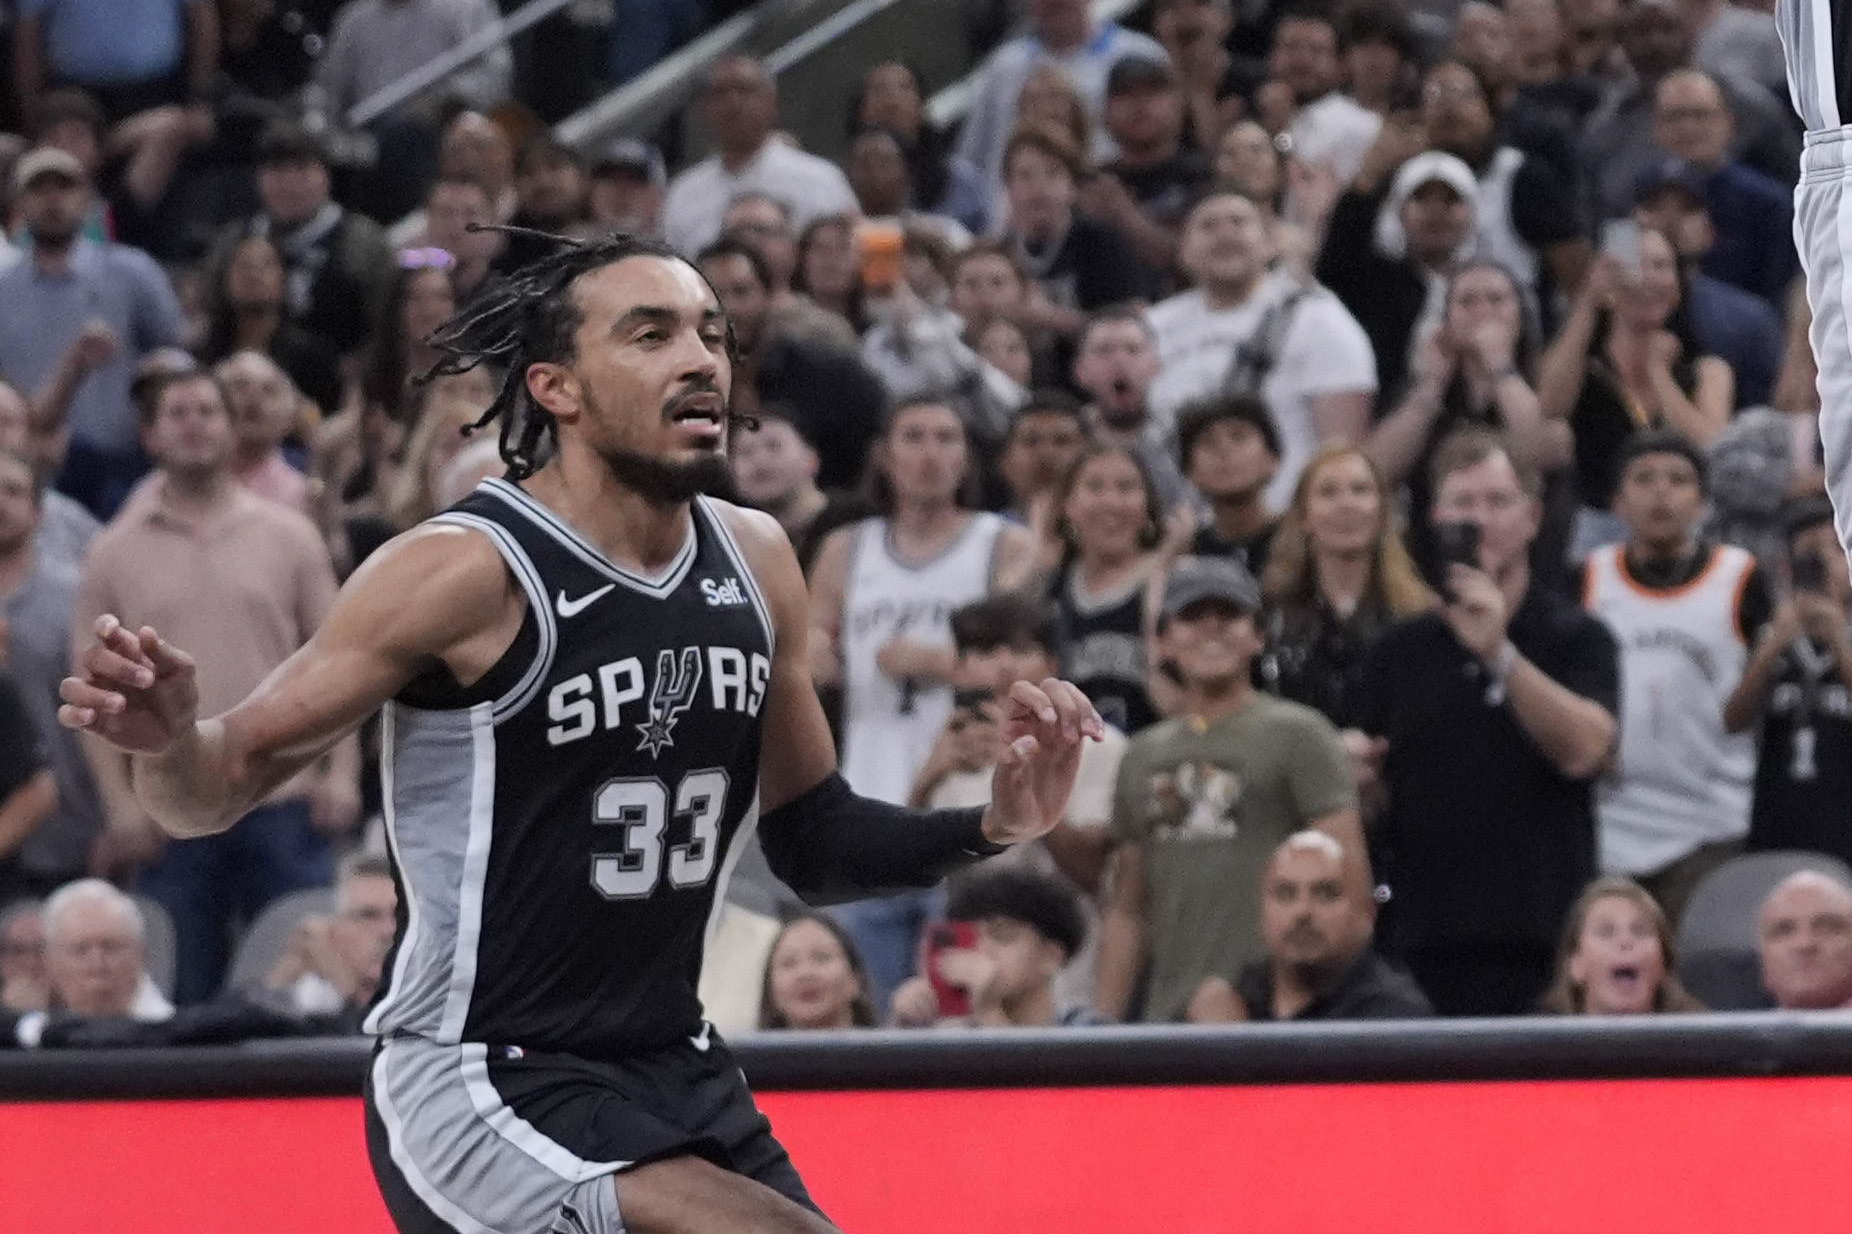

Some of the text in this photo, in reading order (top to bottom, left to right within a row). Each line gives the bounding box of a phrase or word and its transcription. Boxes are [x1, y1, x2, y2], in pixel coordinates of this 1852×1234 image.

[701, 577, 748, 606] Self.
[547, 645, 770, 759] SPURS
[590, 767, 731, 899] 33
